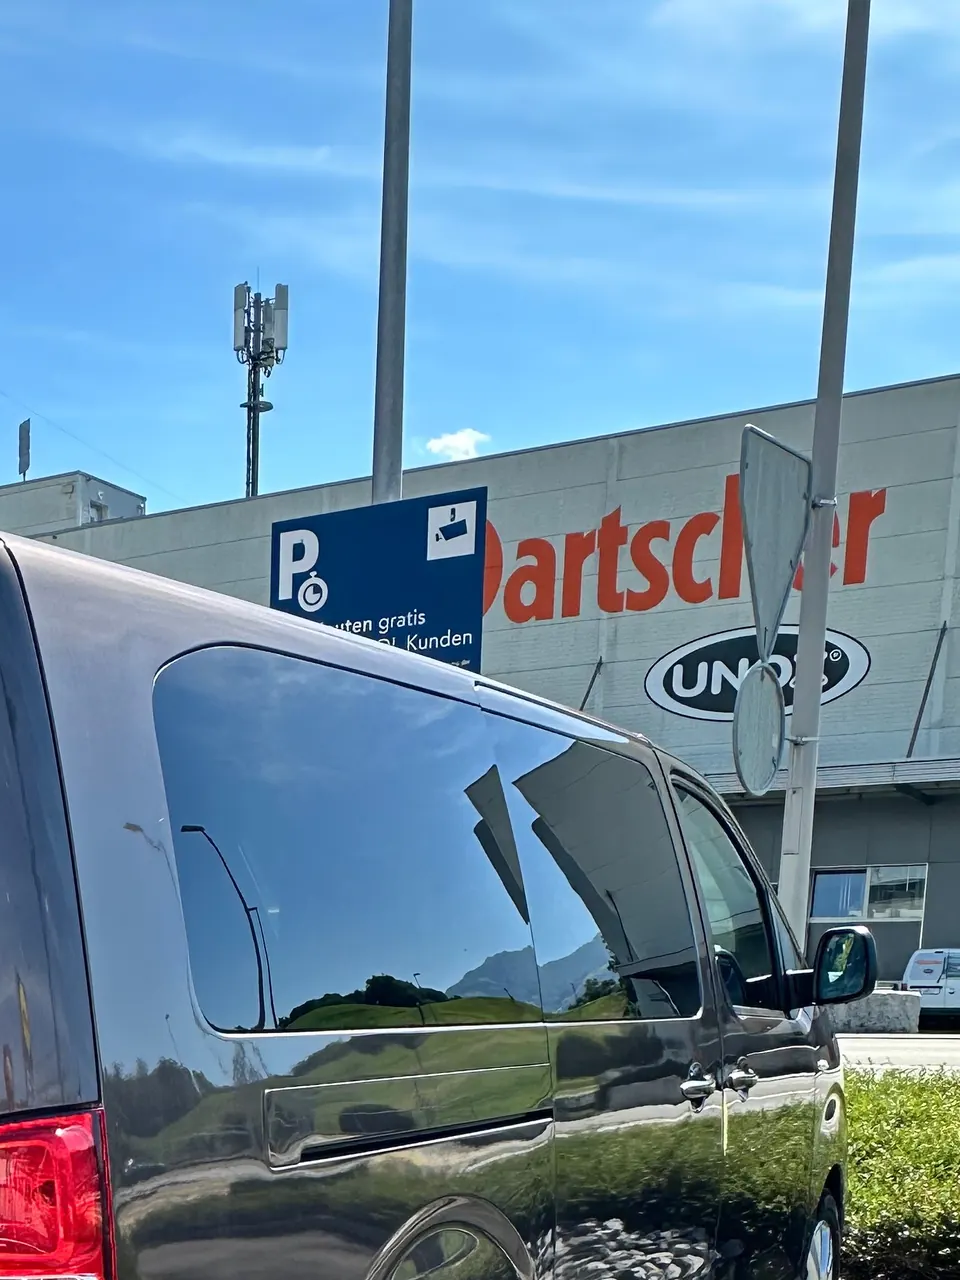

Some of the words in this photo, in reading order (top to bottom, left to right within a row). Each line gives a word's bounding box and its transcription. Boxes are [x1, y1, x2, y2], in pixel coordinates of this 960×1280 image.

[279, 529, 320, 600] P
[483, 474, 886, 623] artscr
[378, 608, 426, 634] gratis
[407, 629, 472, 651] Kunden
[671, 651, 829, 698] UNO
